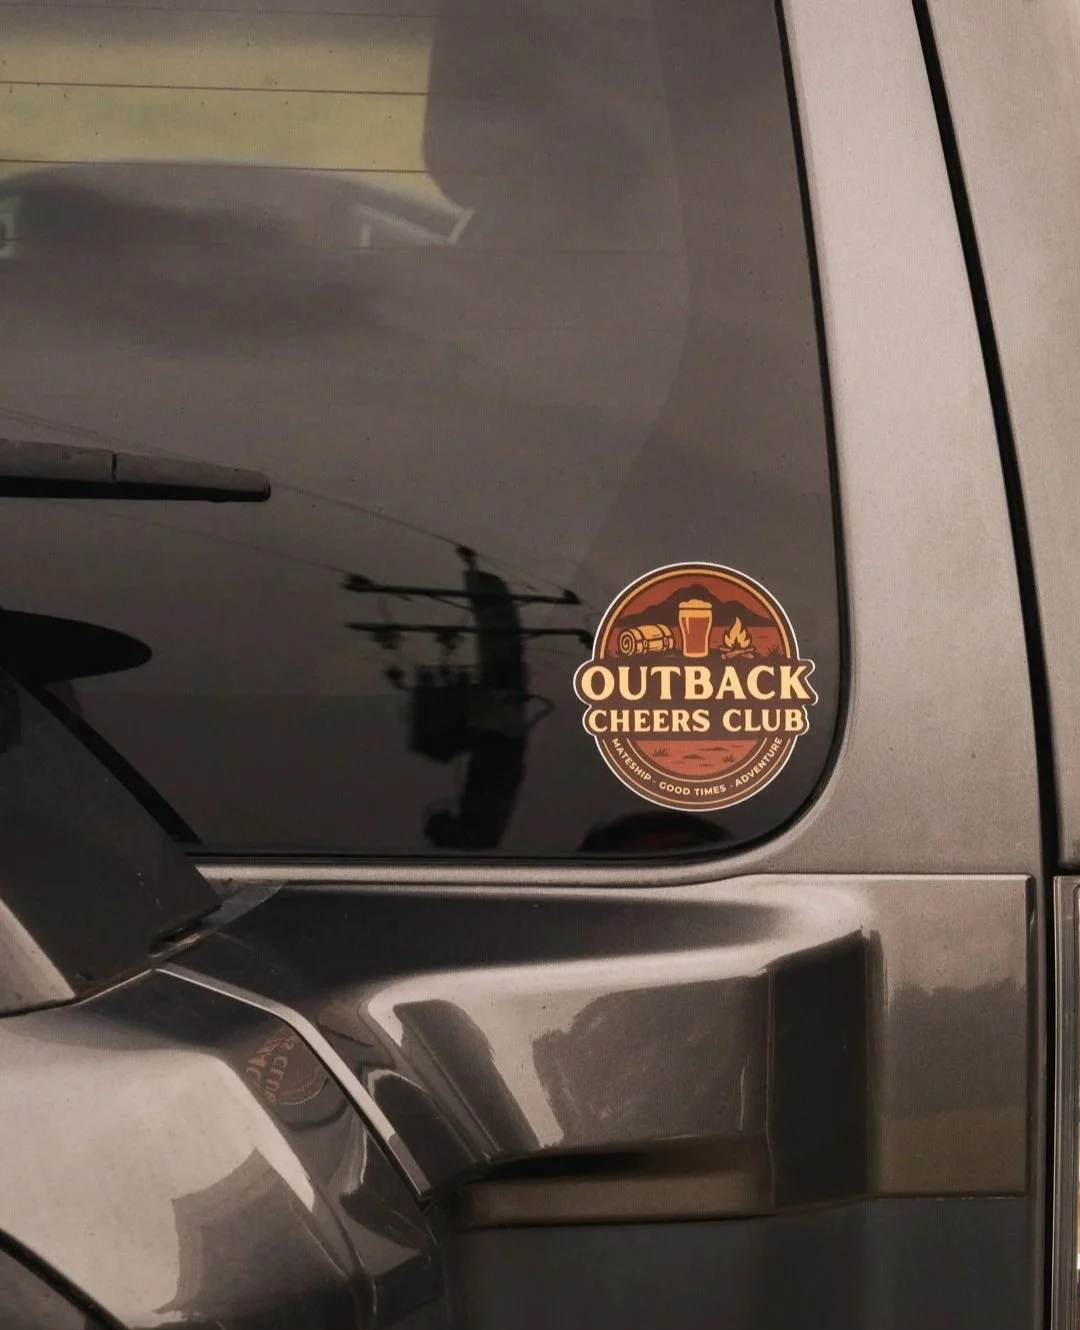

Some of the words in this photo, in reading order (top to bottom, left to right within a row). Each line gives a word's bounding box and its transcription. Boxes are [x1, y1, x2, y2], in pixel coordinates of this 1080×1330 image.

[581, 666, 811, 701] OUTBACK
[588, 709, 711, 733] CHEERS
[722, 709, 805, 733] CLUB
[611, 738, 652, 782] MATESHIP
[659, 781, 691, 796] GOOD
[694, 784, 726, 797] TIMES
[735, 737, 783, 787] ADVENTURE
